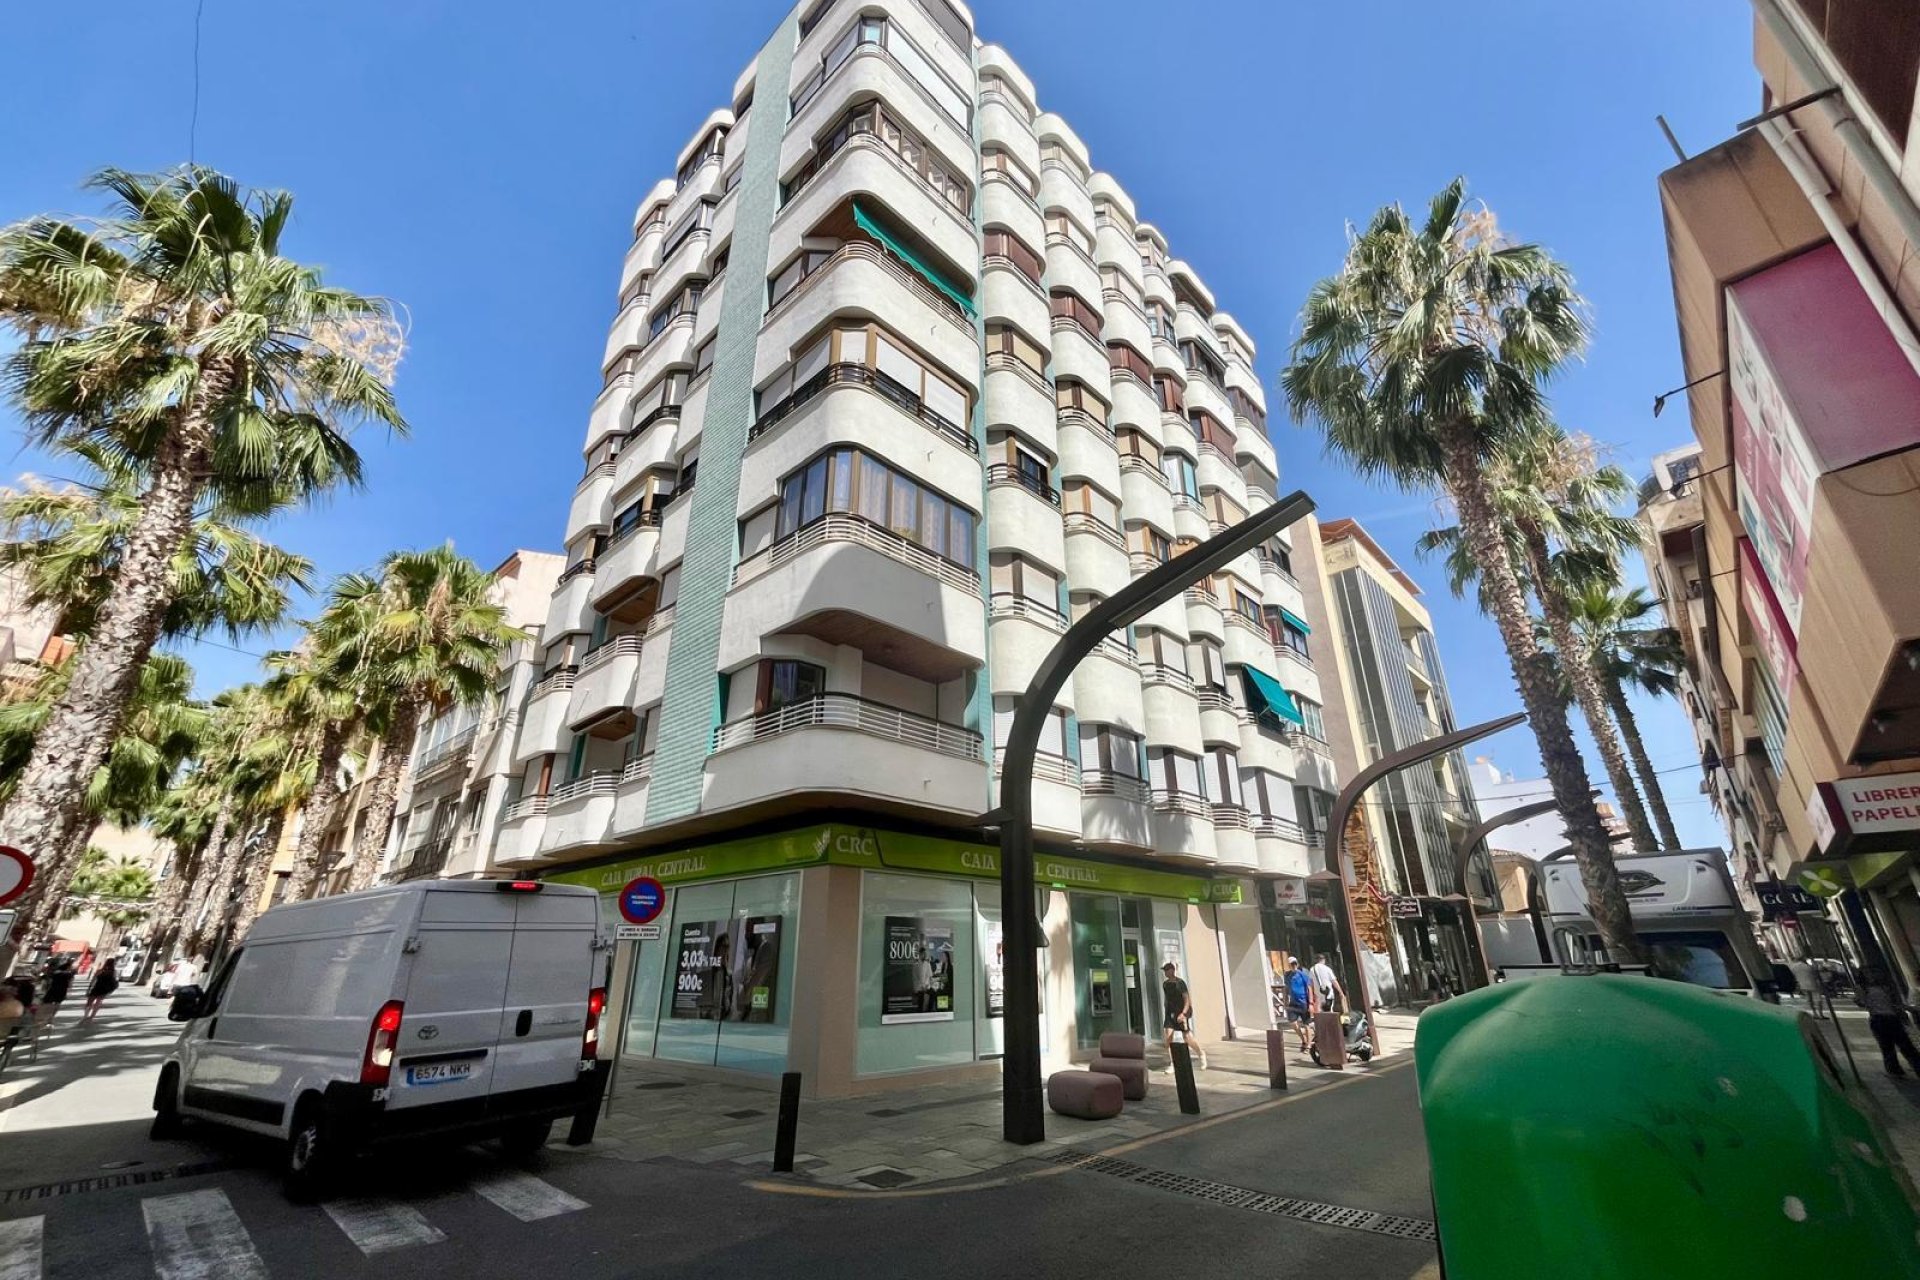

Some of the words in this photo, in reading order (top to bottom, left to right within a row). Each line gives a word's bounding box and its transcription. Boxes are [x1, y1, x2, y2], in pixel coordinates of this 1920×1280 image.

[1853, 786, 1920, 802] LIBRER
[836, 835, 873, 856] CRC
[658, 856, 706, 876] CENTRAL
[1047, 863, 1099, 882] CENTRAL
[889, 940, 920, 959] 800€
[450, 1063, 471, 1076] NKH
